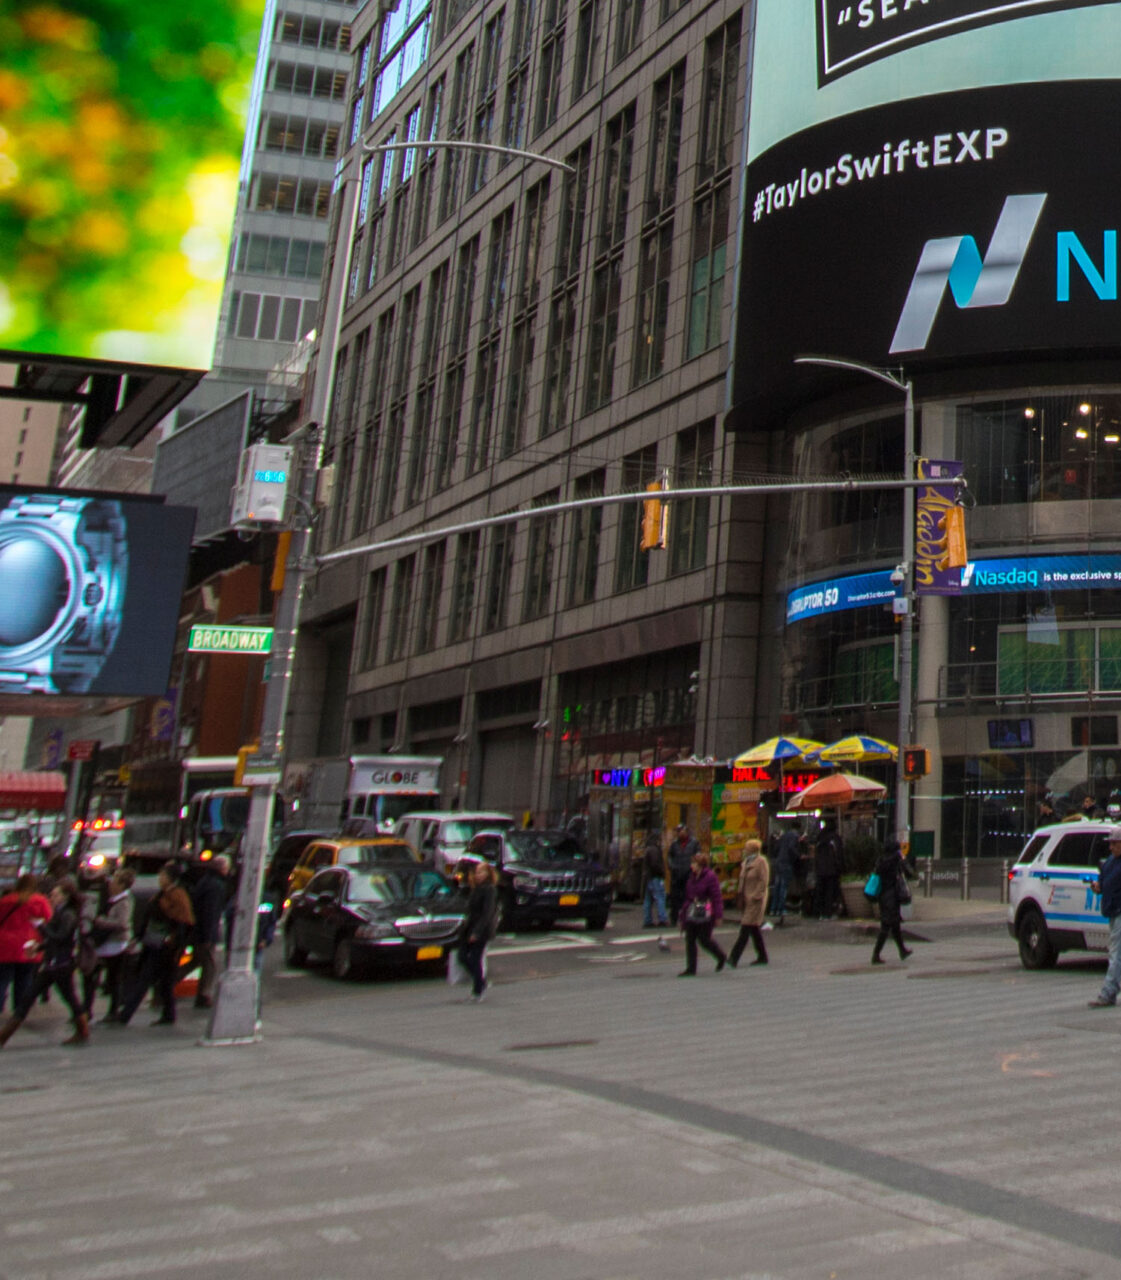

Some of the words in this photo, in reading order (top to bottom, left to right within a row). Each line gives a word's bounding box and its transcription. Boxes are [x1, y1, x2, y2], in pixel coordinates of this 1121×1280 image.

[752, 127, 1008, 222] #TaylorSwiftEXP
[975, 567, 1038, 587] Nasdaq
[1043, 572, 1051, 582] is
[1053, 571, 1069, 581] the
[824, 587, 839, 607] 50
[193, 631, 267, 650] BROADWAY
[372, 771, 420, 785] GLOBE
